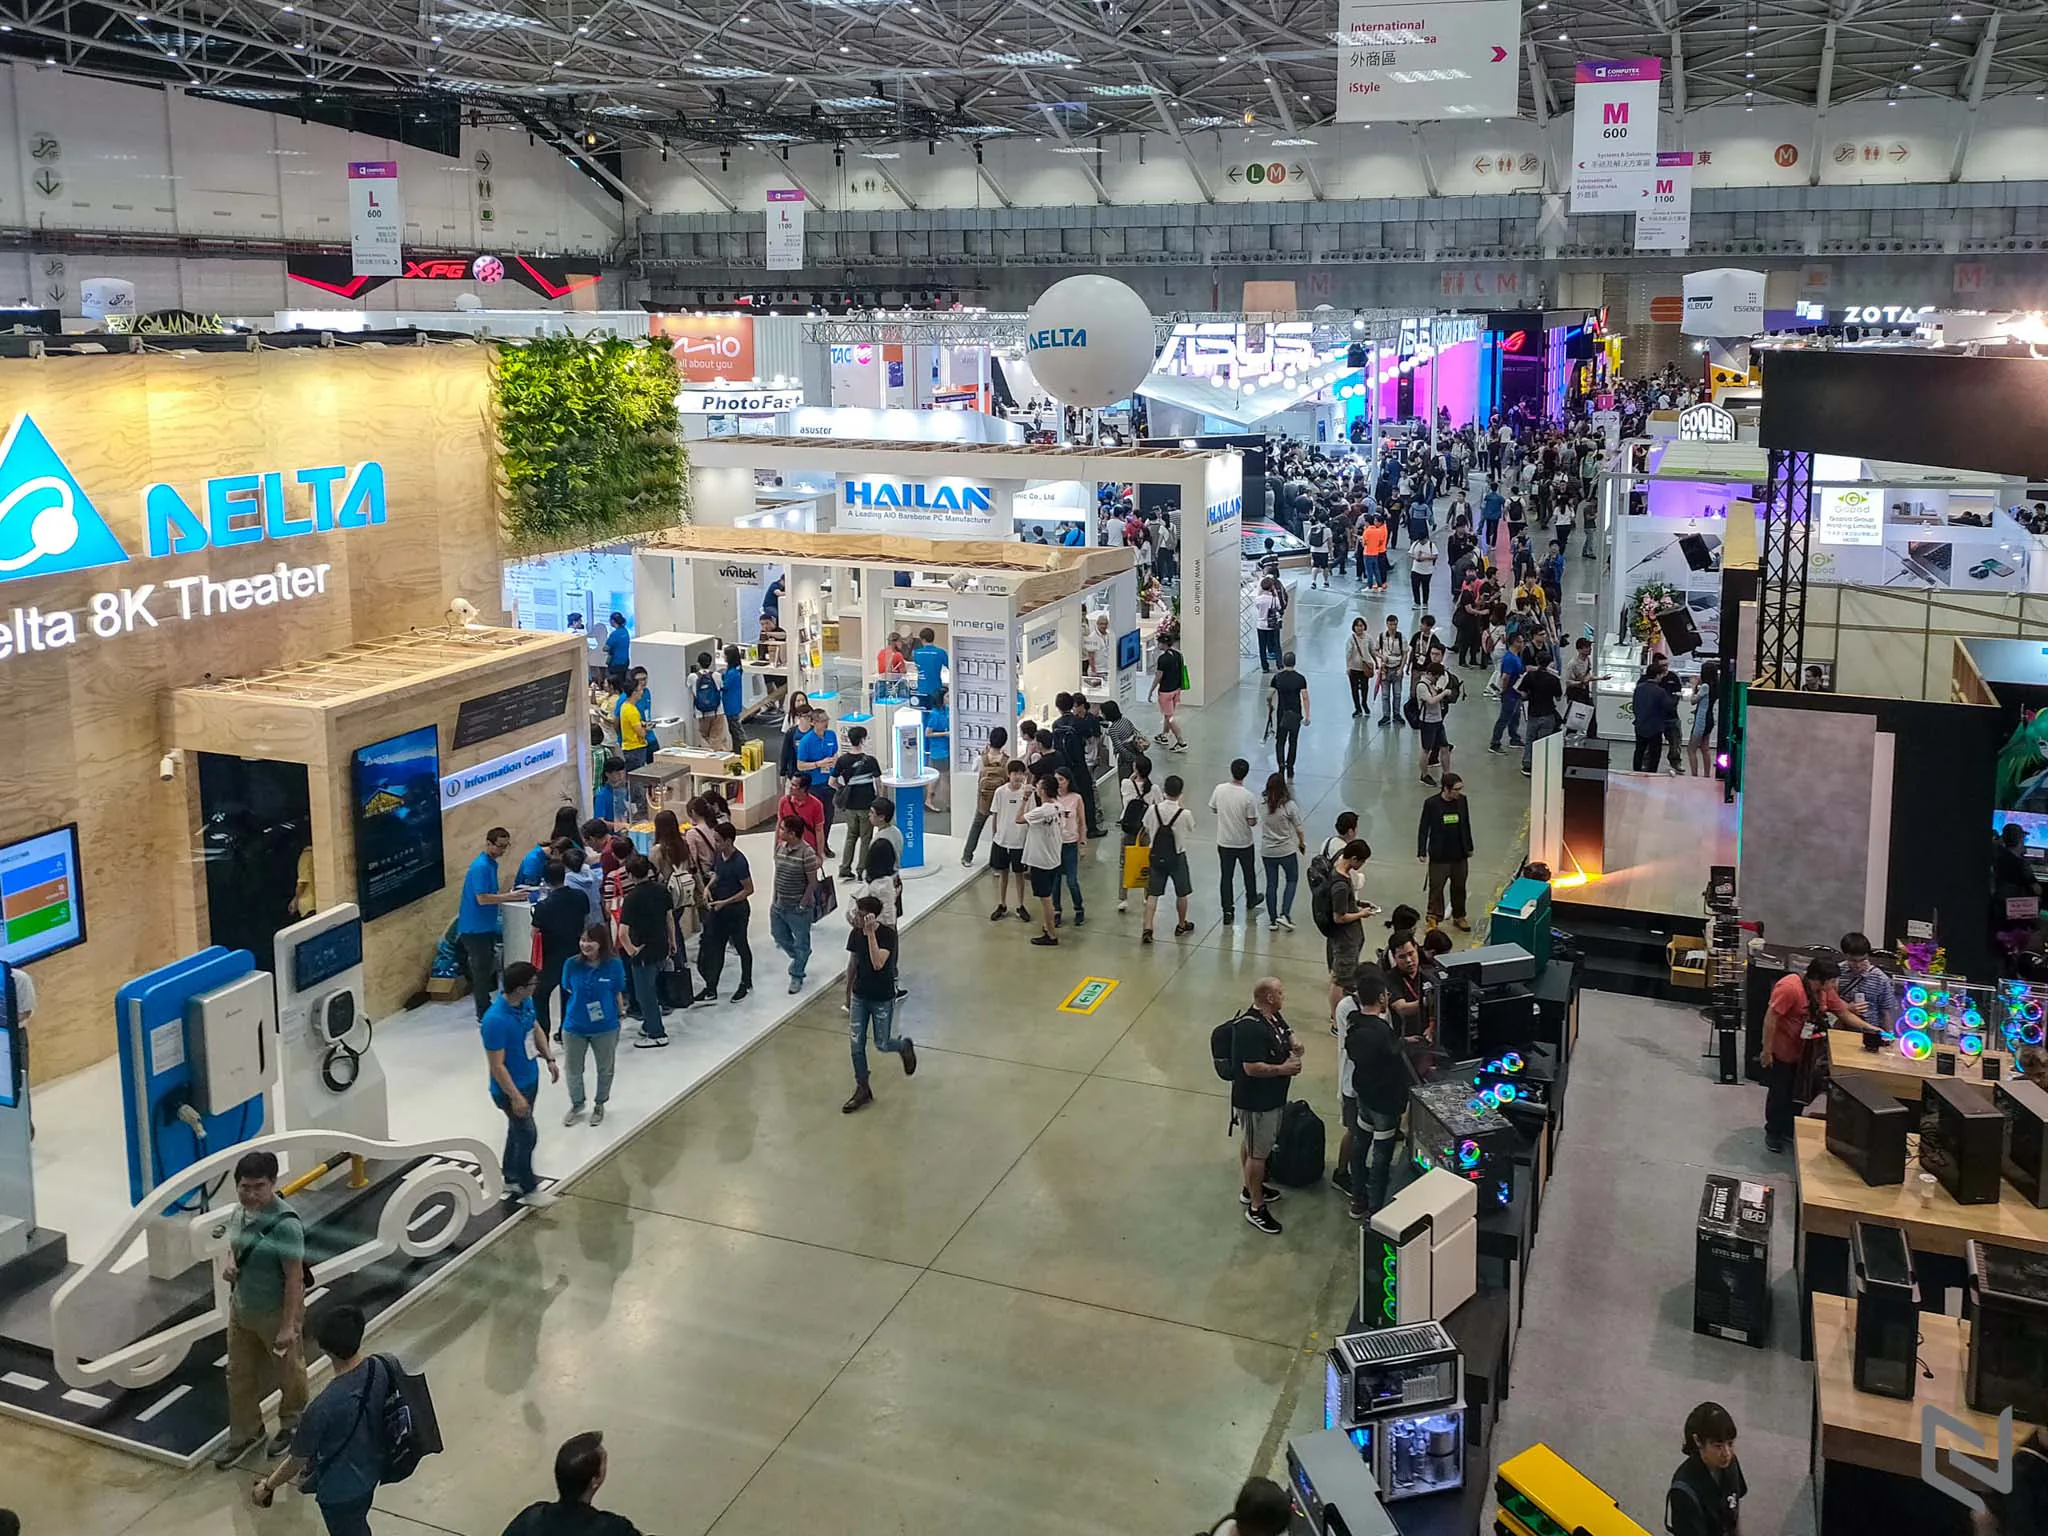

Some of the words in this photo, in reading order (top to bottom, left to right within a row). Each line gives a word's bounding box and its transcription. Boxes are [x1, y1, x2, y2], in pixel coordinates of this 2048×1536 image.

[1351, 19, 1425, 33] International
[1350, 50, 1396, 67] 外商區
[1349, 81, 1381, 94] iStyle
[1603, 102, 1629, 124] M
[1603, 127, 1627, 139] 600
[1697, 151, 1712, 165] 東
[1779, 149, 1794, 164] M
[1250, 166, 1261, 181] L
[1270, 166, 1284, 181] M
[1656, 180, 1673, 194] M
[368, 190, 380, 207] L
[1654, 195, 1675, 203] 1100
[367, 209, 382, 218] 600
[781, 210, 789, 222] L
[402, 260, 468, 278] XPG
[1153, 322, 1314, 378] ASUS
[689, 359, 714, 369] about
[701, 395, 800, 410] PhotoFast
[1681, 407, 1731, 434] COOLER
[845, 480, 991, 511] HAILAN
[142, 461, 388, 558] DELTA
[855, 511, 882, 520] Leading
[898, 513, 931, 521] Barebone
[944, 514, 992, 523] Manufacturer
[1208, 496, 1241, 525] HAILAN
[719, 565, 758, 579] vivitek
[90, 584, 159, 639] 8K
[165, 561, 331, 620] Theater
[464, 760, 522, 790] Information
[523, 748, 555, 767] Center
